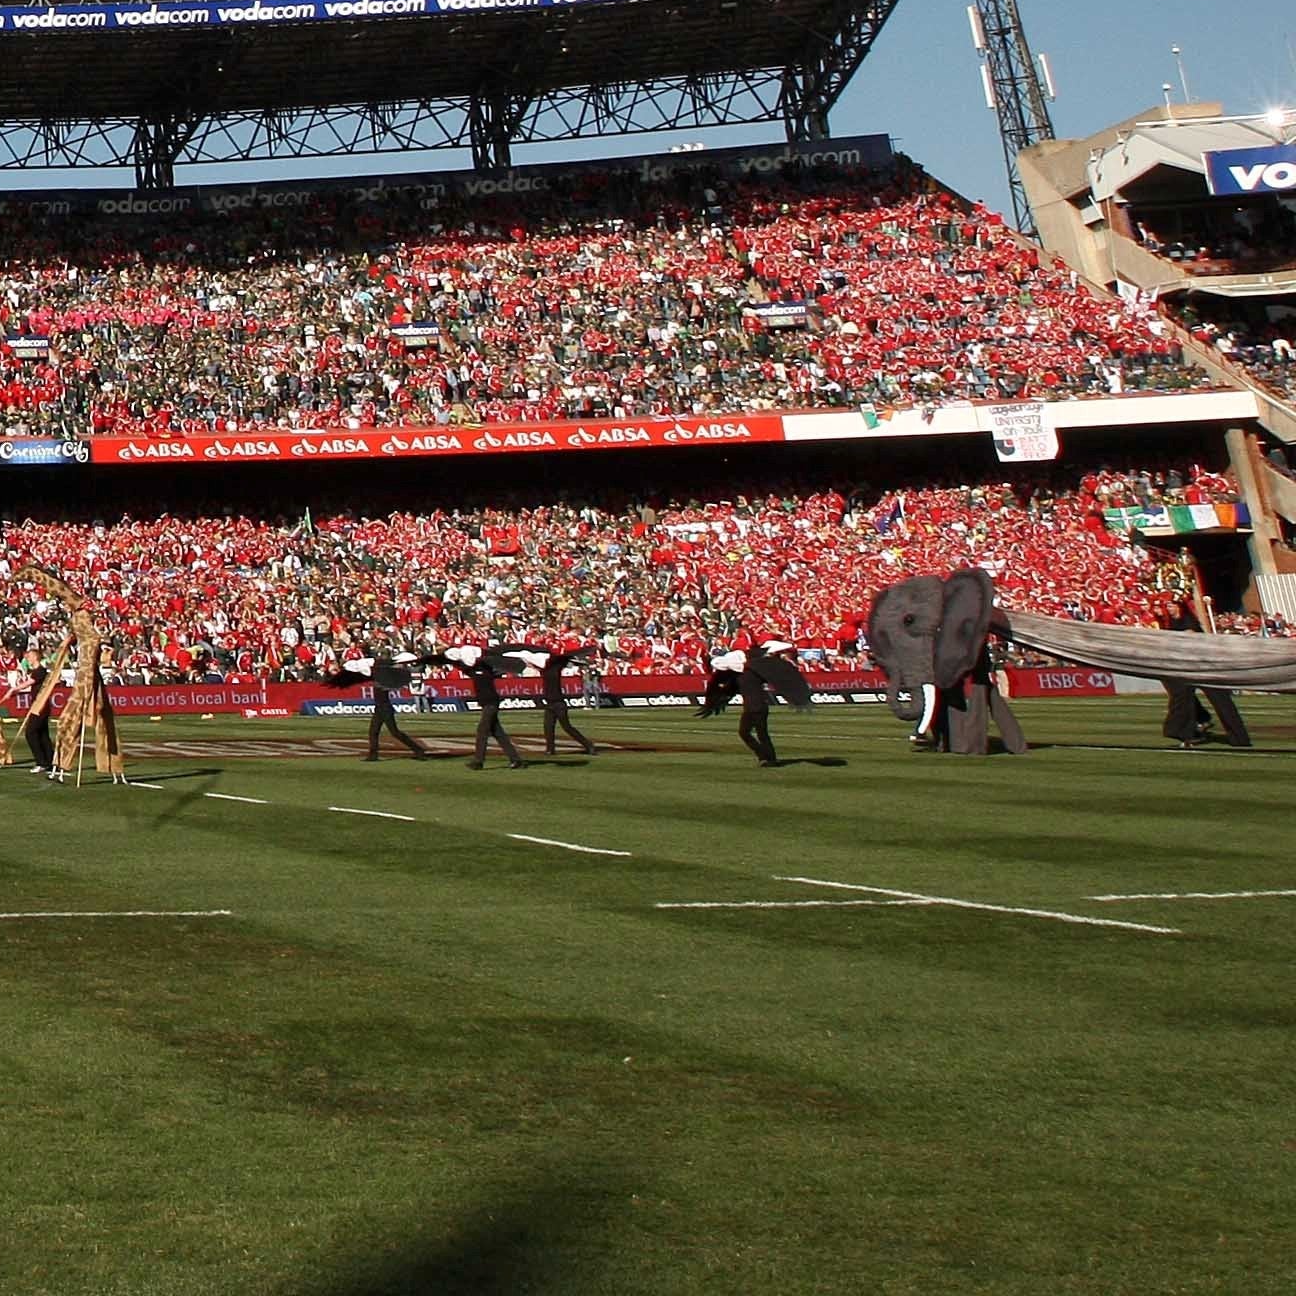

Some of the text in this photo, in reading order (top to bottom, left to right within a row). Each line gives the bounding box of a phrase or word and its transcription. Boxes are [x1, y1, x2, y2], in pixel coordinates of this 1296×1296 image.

[13, 8, 106, 27] vodacom
[115, 5, 208, 25] vodacom
[218, 1, 315, 21] vodacom
[147, 422, 751, 458] ABSA ABSA ABSA ABSA ABSA ABSA ABSA
[62, 440, 89, 463] City
[1039, 672, 1084, 689] HSBC
[132, 691, 186, 707] world's
[191, 690, 226, 705] local
[649, 694, 690, 705] adidas
[261, 707, 288, 716] CASTLE
